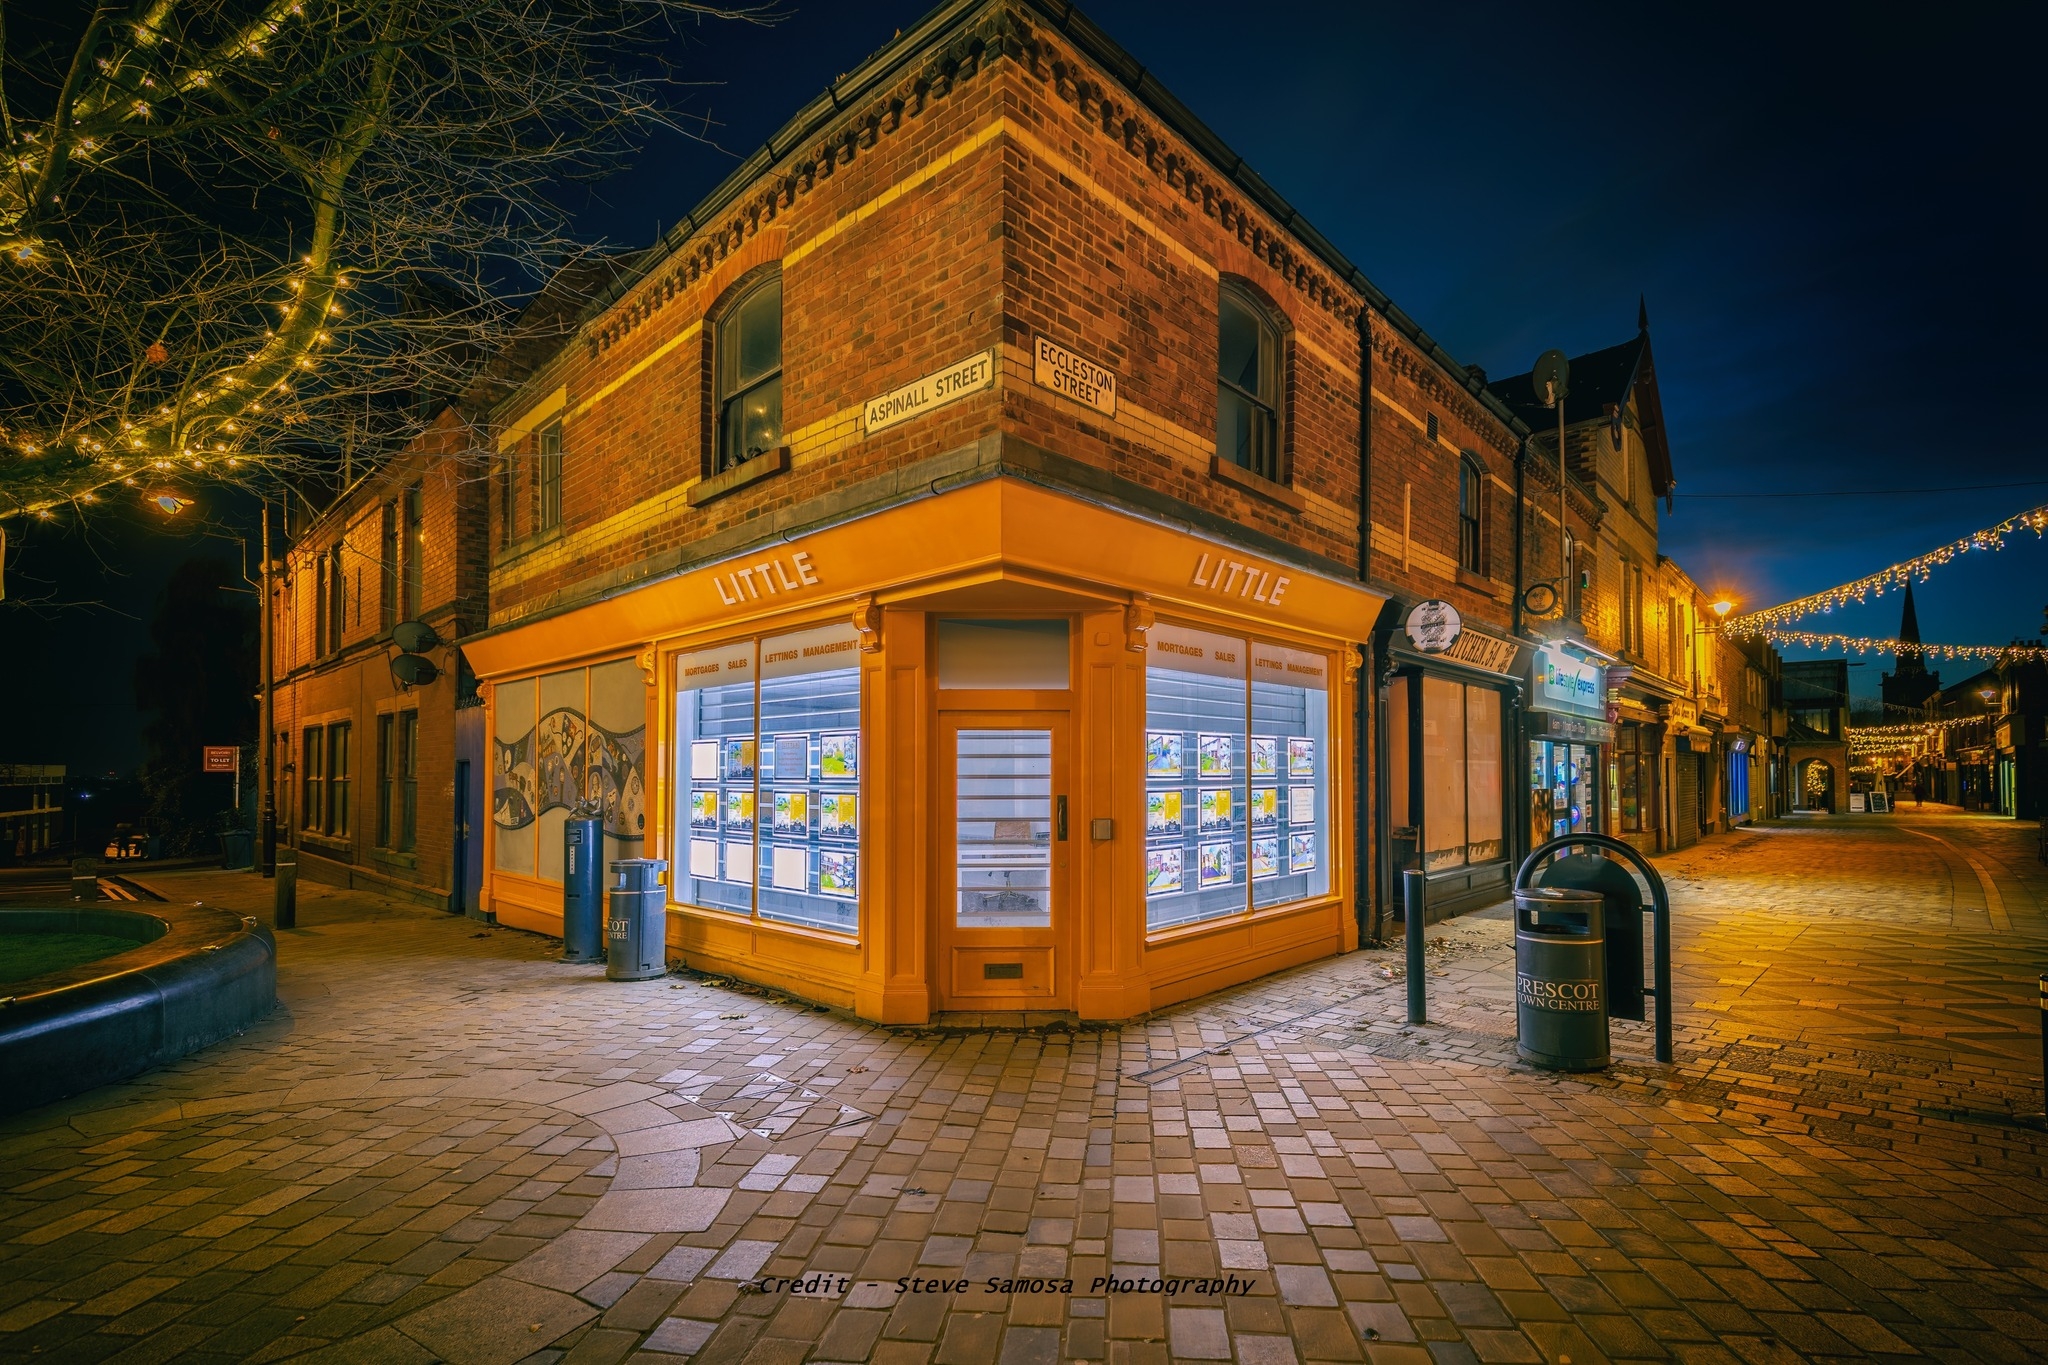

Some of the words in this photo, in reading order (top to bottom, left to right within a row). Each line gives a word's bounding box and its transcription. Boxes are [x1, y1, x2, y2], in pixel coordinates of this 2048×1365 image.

[1041, 343, 1112, 392] ECCLESTON
[869, 386, 929, 425] ASPINALL
[936, 359, 988, 397] STREET
[1053, 369, 1101, 405] STREET
[714, 552, 818, 605] LITTLE
[1194, 553, 1290, 606] LITTLE
[765, 650, 798, 663] LETTINGS
[803, 639, 858, 657] MANAGEMENT
[1157, 641, 1203, 658] MORTGAGES
[1215, 651, 1236, 662] SALES
[685, 663, 719, 677] MORTGAGES
[728, 659, 747, 670] SALES
[1255, 658, 1282, 670] LETTINGS
[1287, 663, 1323, 677] MANAGEMENT
[1517, 976, 1599, 999] PRESCOT
[1518, 992, 1545, 1007] TOWN
[1549, 999, 1600, 1010] CENTRE
